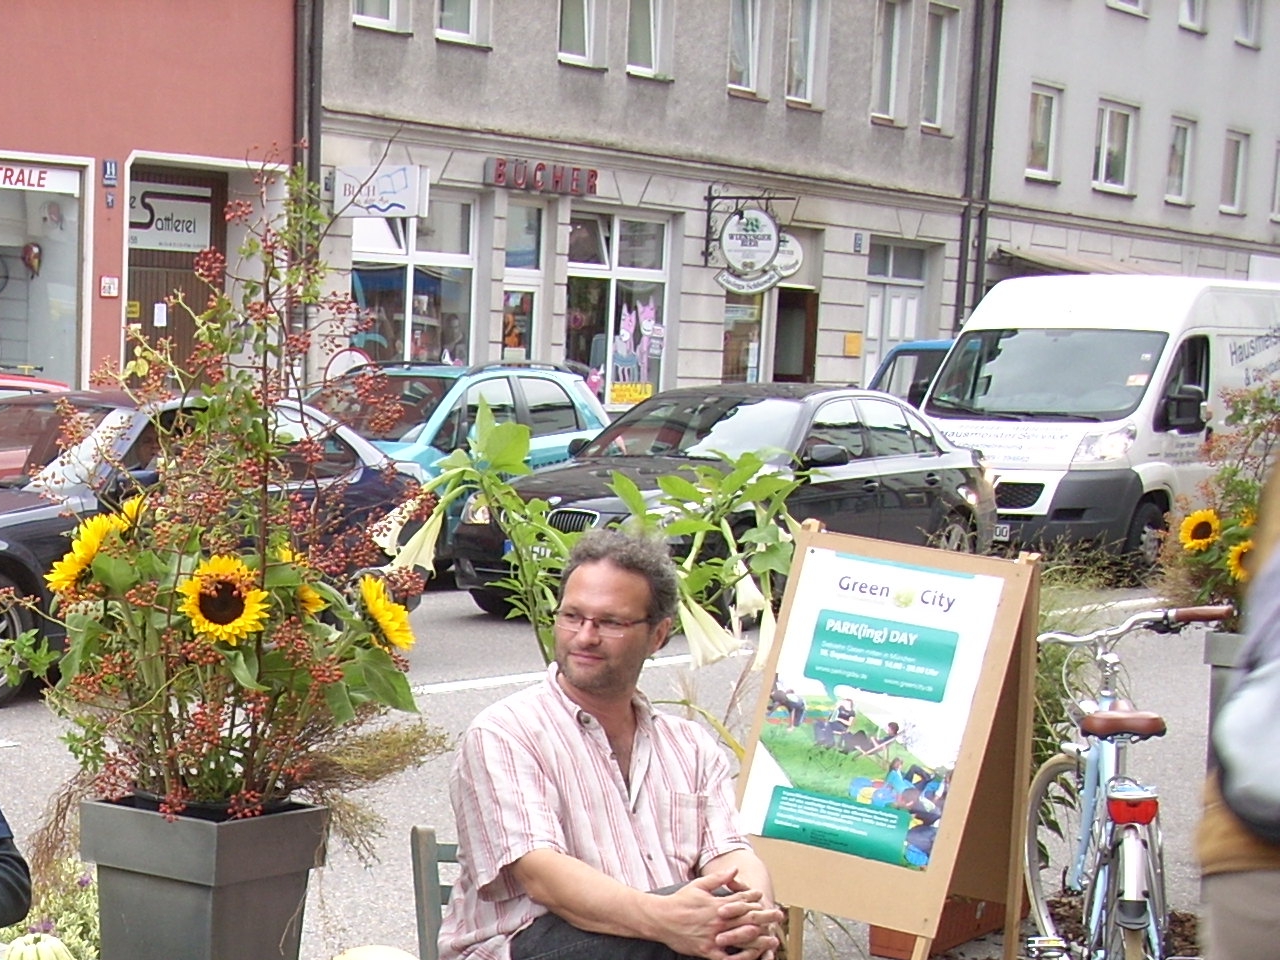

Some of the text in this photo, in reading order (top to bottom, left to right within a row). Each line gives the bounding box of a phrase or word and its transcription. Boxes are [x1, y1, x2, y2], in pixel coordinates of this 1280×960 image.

[494, 157, 599, 195] BÜCHER
[838, 575, 956, 613] Green City
[825, 618, 918, 646] PARK(ing) DAY
